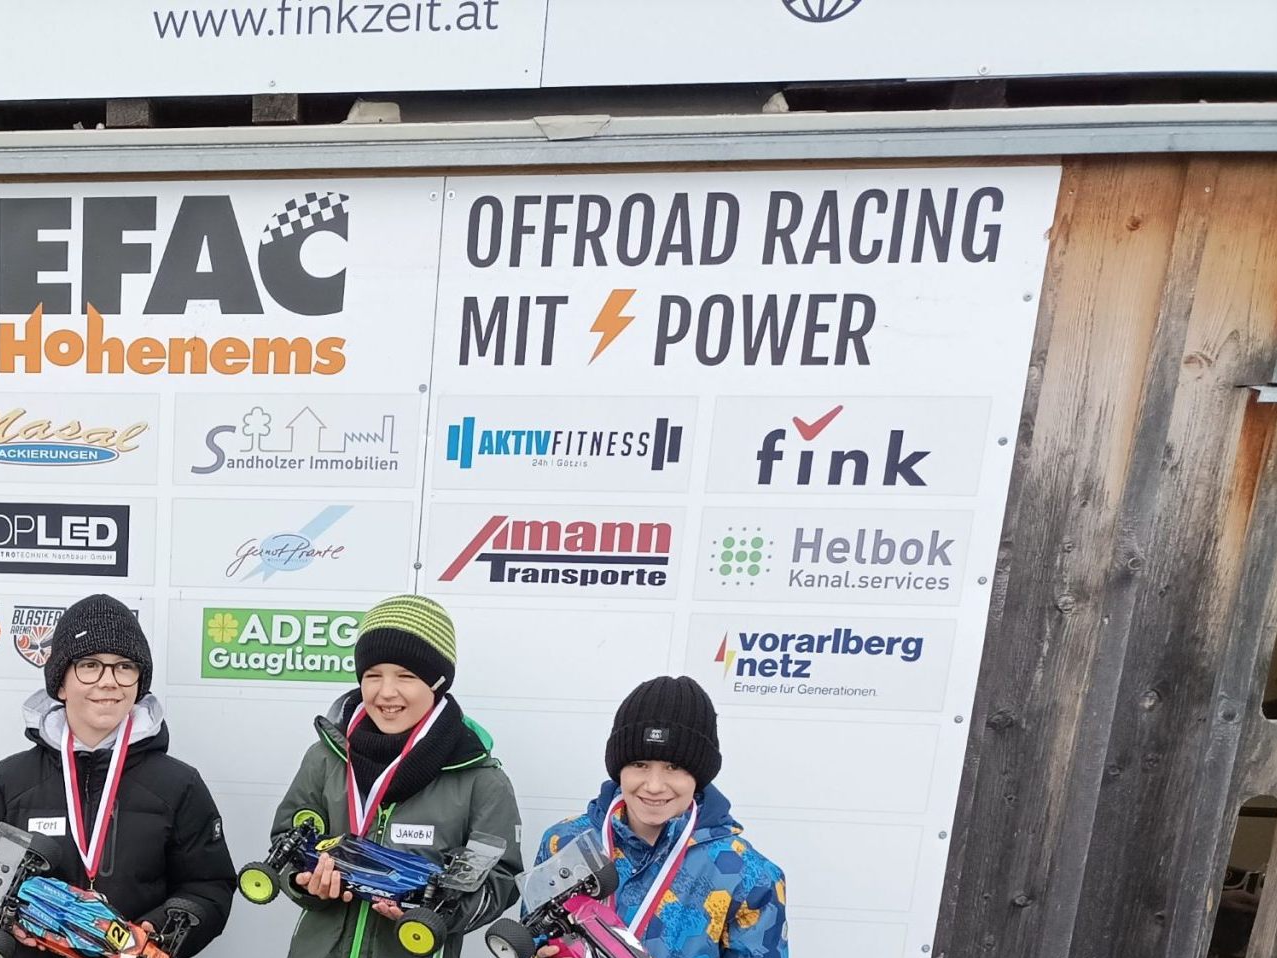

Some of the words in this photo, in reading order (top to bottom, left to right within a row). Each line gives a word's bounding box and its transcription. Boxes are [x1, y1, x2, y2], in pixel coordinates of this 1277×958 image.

[153, 0, 499, 38] www.finkzeit.at
[466, 193, 741, 268] OFFROAD
[761, 186, 1005, 265] RACING
[458, 295, 570, 366] MIT
[654, 293, 877, 367] POWER
[190, 424, 305, 475] Sandholzer
[309, 455, 399, 471] Immobilien
[756, 428, 932, 487] fink
[437, 515, 672, 582] Amann
[791, 527, 956, 566] Helbok
[475, 552, 669, 587] Transporte
[788, 568, 951, 591] Kanal.services
[237, 613, 359, 648] ADEG
[738, 627, 925, 663] vorarlberg
[735, 653, 812, 679] netz
[733, 681, 778, 696] Energie
[779, 682, 796, 695] für
[395, 827, 425, 839] JAKOB
[111, 926, 125, 943] 2
